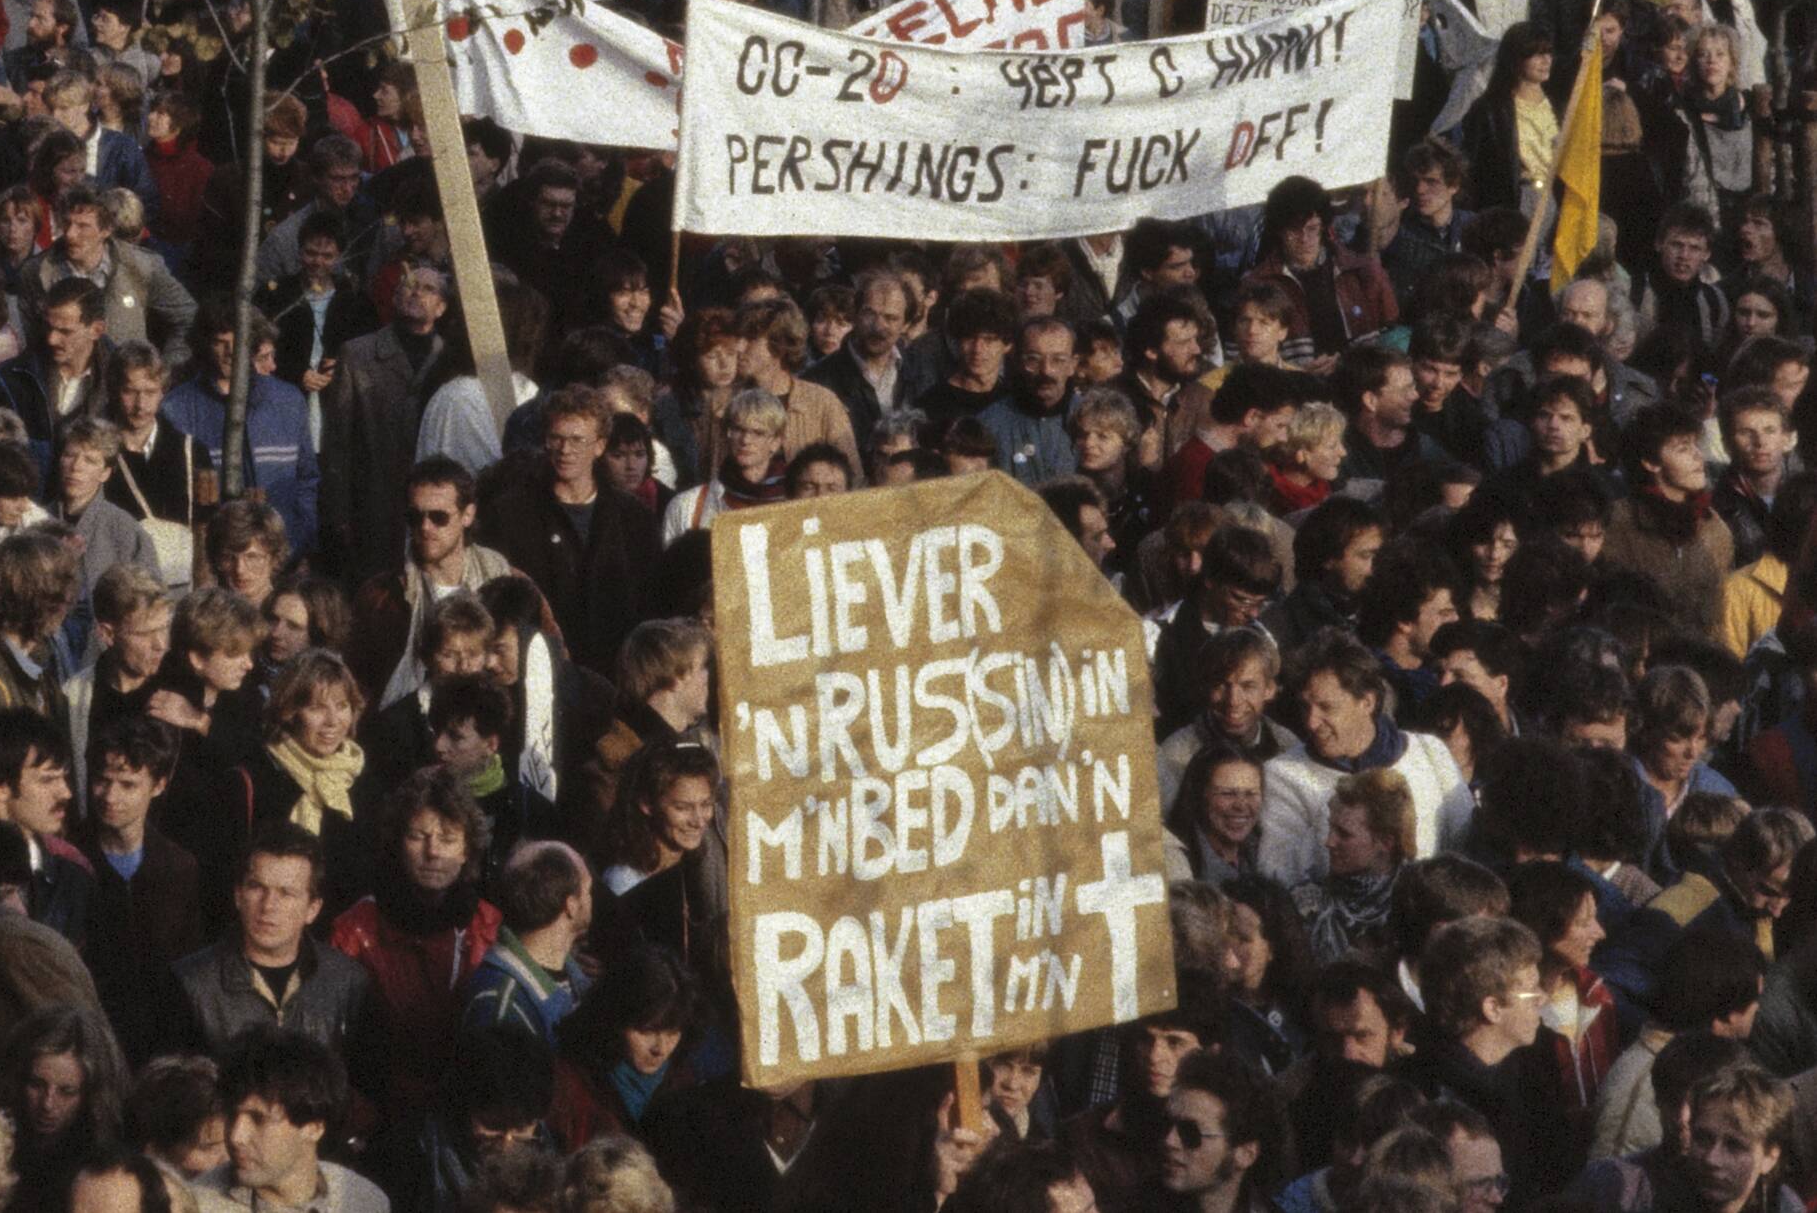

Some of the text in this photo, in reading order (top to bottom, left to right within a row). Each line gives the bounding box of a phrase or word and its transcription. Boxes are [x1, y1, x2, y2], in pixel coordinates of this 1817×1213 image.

[726, 98, 1335, 203] PERSHINGS: FUCK OFF!
[849, 764, 977, 882] BED
[987, 763, 1080, 834] DAN
[753, 889, 1016, 1066] RAKET
